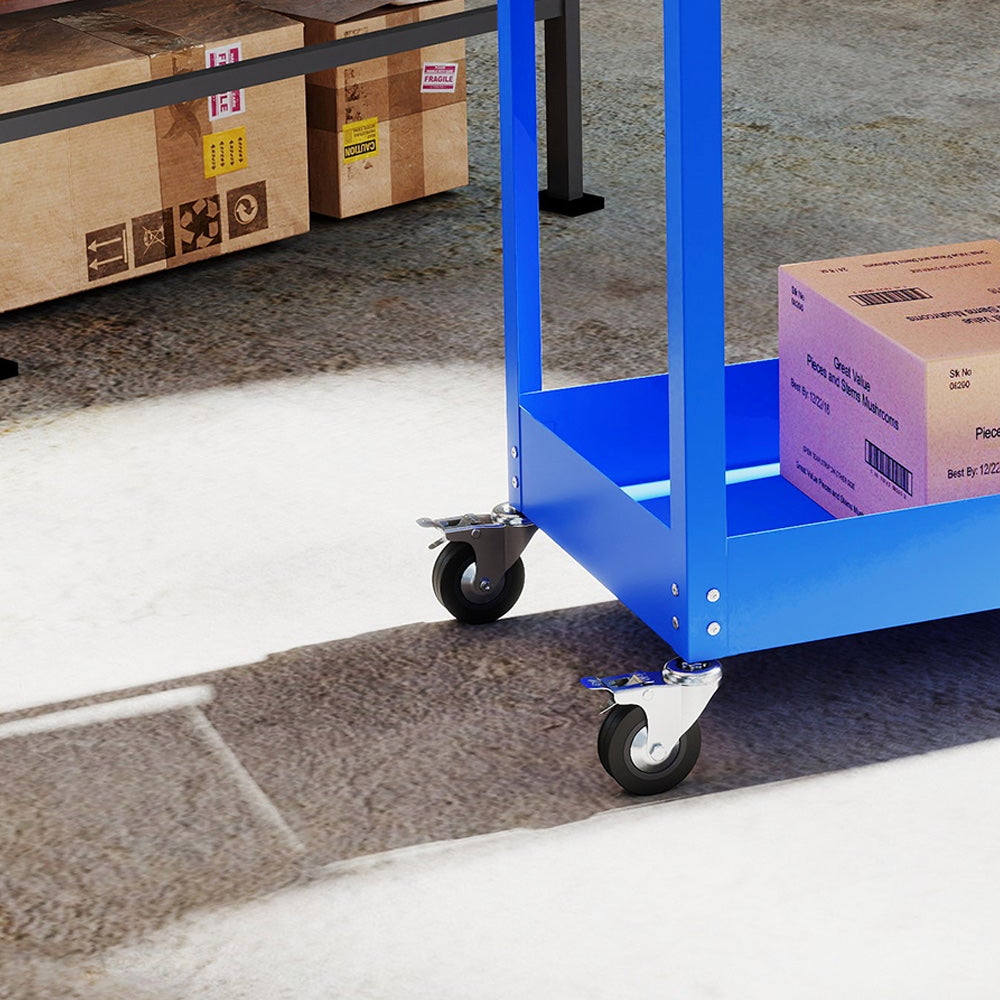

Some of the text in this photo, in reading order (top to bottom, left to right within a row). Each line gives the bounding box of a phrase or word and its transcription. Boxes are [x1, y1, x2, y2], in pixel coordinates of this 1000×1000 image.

[424, 75, 453, 83] FRAGILE
[345, 141, 376, 157] CAUTION
[834, 357, 871, 392] Great Value
[949, 368, 972, 379] Stk No
[806, 354, 900, 431] Pieces and Stems Mushrooms
[948, 468, 964, 479] Best
[966, 466, 978, 478] By:
